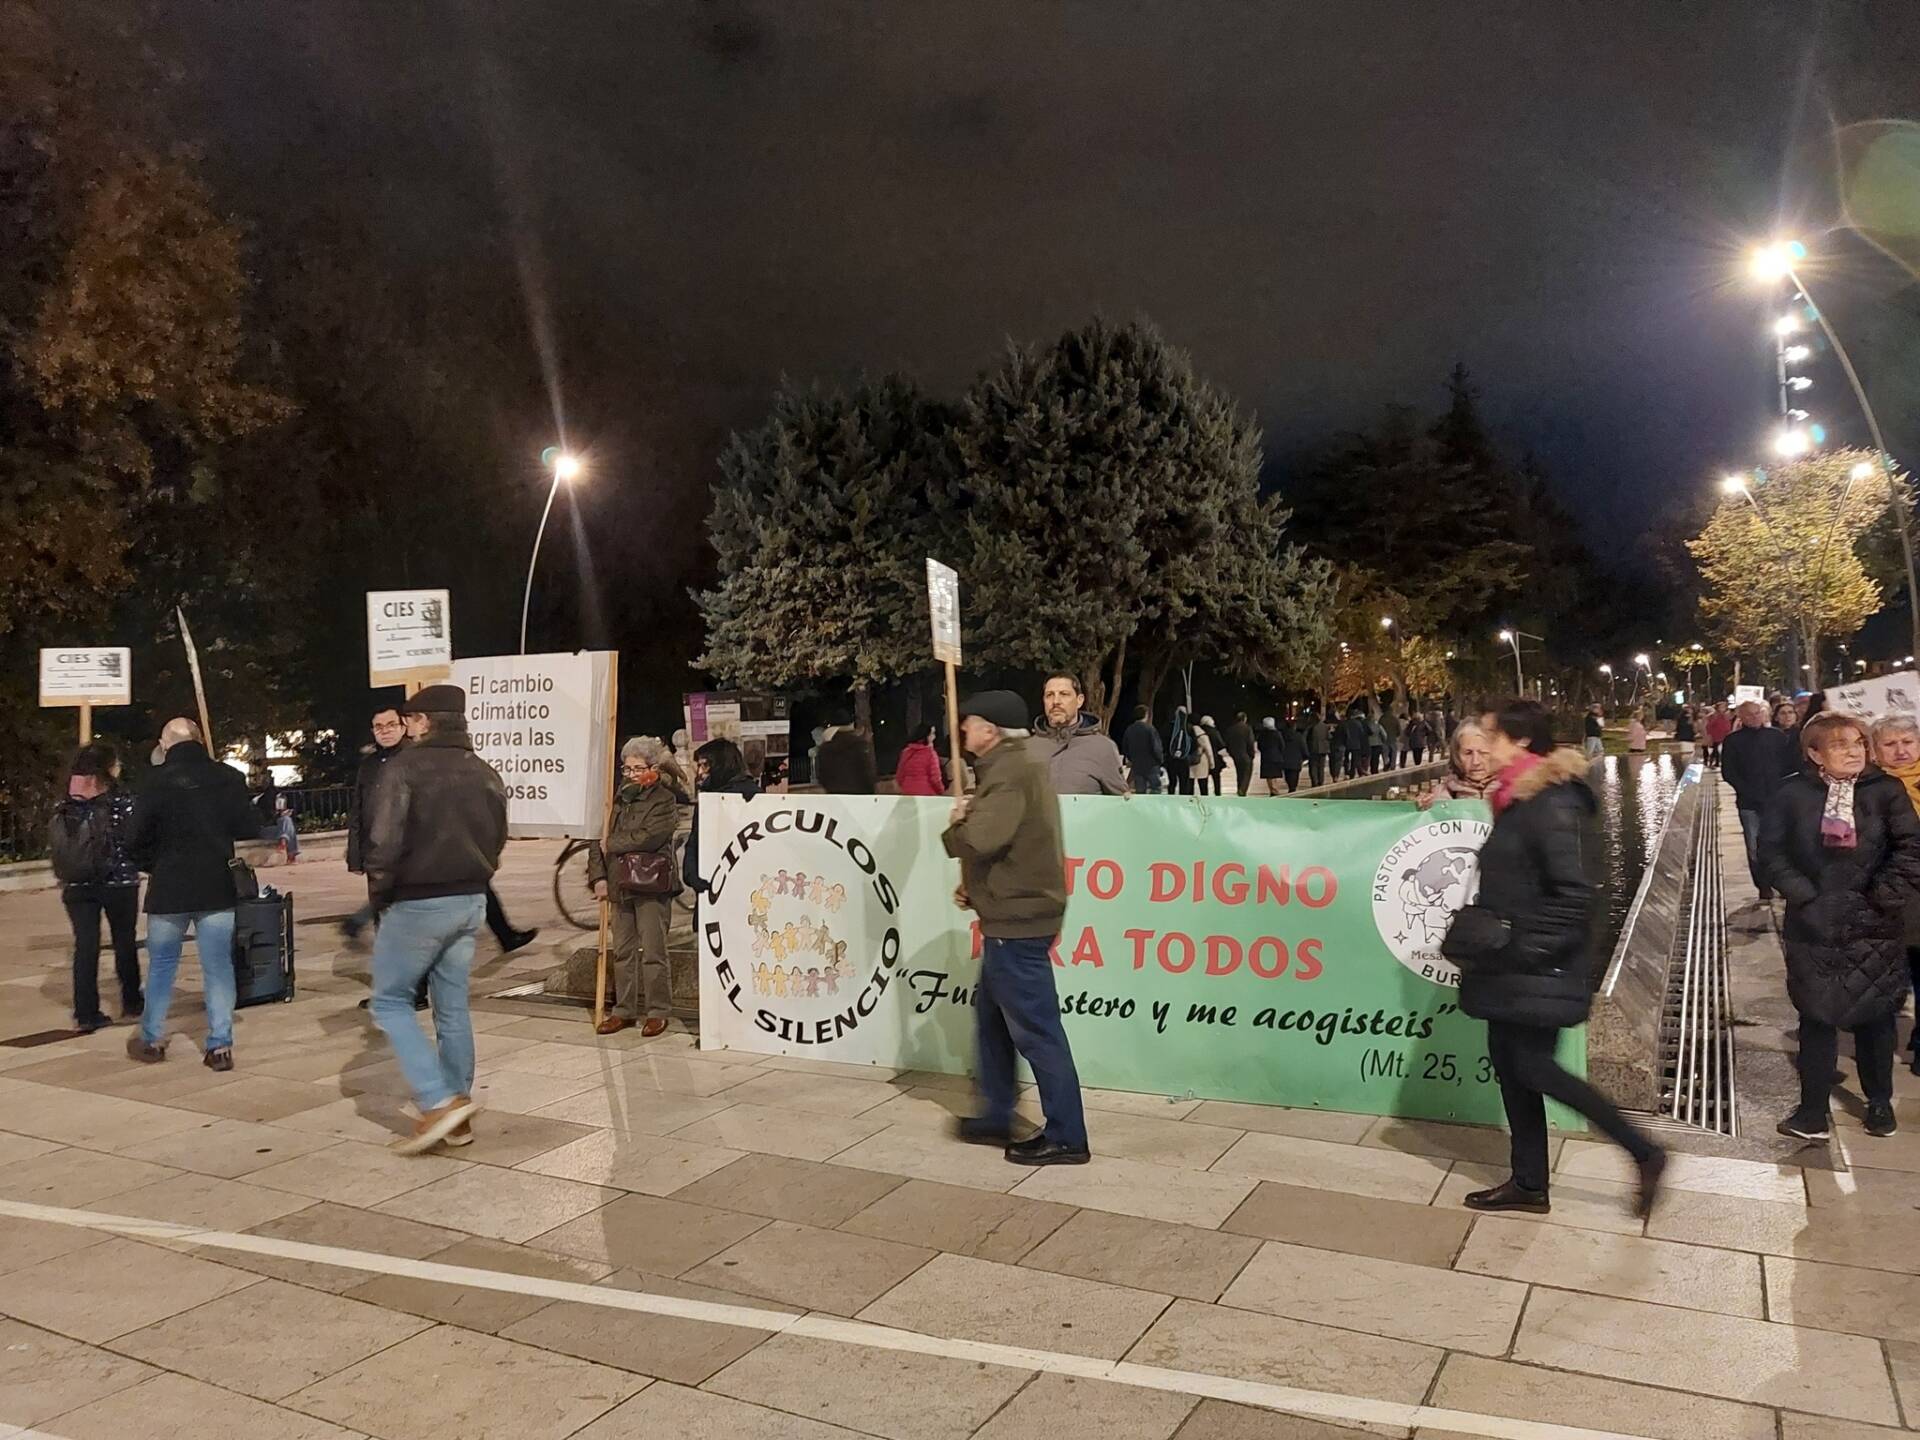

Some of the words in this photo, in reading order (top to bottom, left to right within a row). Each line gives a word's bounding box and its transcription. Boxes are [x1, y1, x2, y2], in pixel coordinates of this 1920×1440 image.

[384, 601, 415, 618] CIES
[469, 676, 485, 695] El
[489, 674, 554, 694] cambio
[471, 702, 550, 721] climático
[529, 726, 556, 747] las
[487, 753, 566, 774] raciones
[505, 784, 549, 801] osas
[708, 809, 900, 915] CIRCULOS
[1374, 834, 1422, 902] PASTORAL
[1428, 821, 1463, 837] CON
[1473, 822, 1491, 838] IN
[1064, 857, 1125, 900] TO
[1147, 861, 1338, 908] DIGNO
[705, 921, 743, 1013] DEL
[1123, 927, 1324, 981] TODOS
[1410, 950, 1443, 961] Mesa
[754, 927, 900, 1045] SILENCIO
[1421, 963, 1463, 987] BUR
[1060, 990, 1136, 1019] stero
[1152, 999, 1171, 1034] y
[1186, 1000, 1238, 1026] me
[1360, 1048, 1411, 1082] (Mt.
[1422, 1052, 1463, 1087] 25,
